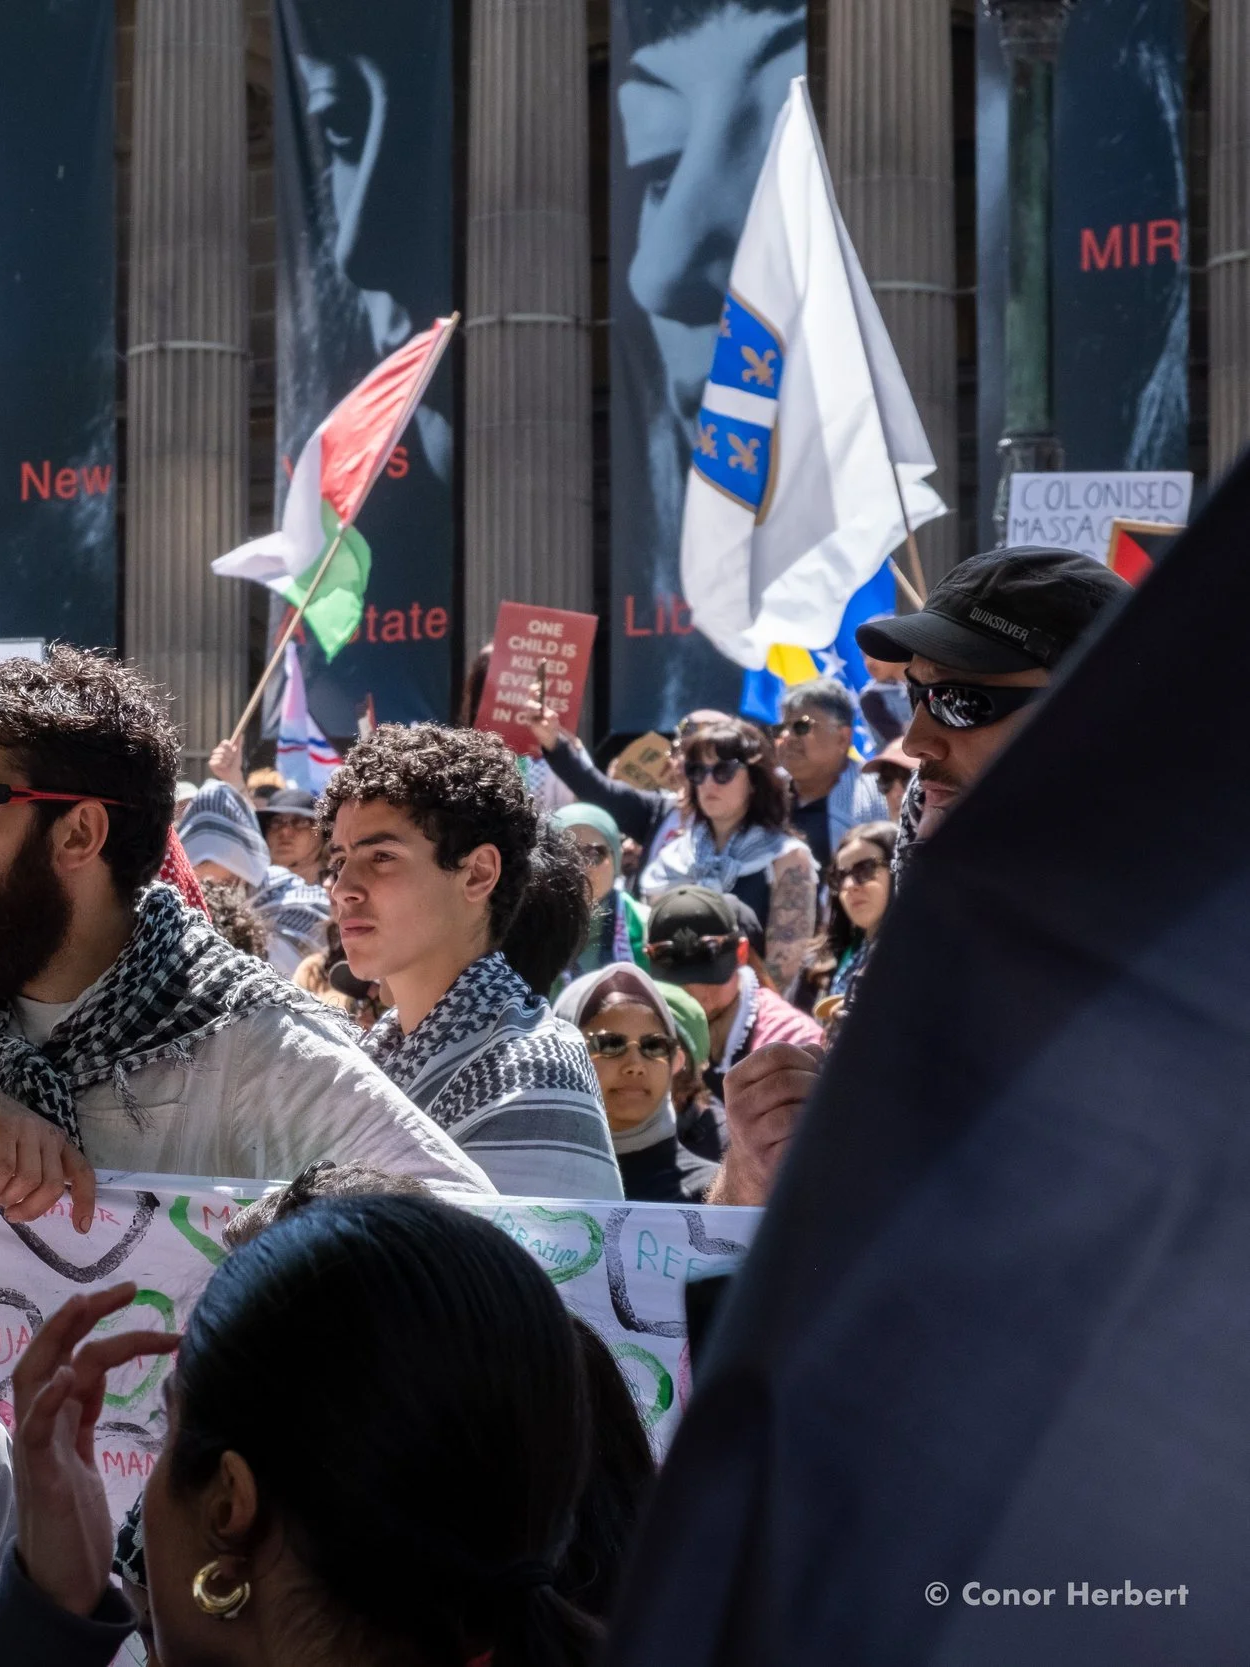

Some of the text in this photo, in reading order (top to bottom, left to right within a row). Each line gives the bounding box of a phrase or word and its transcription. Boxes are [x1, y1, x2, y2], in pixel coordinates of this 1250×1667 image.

[1080, 218, 1180, 271] MIR
[21, 460, 113, 501] New
[1021, 479, 1184, 512] COLONISED
[345, 602, 447, 645] tate
[528, 619, 564, 637] ONE
[970, 607, 1029, 641] QUIKSILVER
[508, 636, 577, 658] CHILD IS
[557, 680, 573, 694] 10
[492, 707, 512, 722] IN
